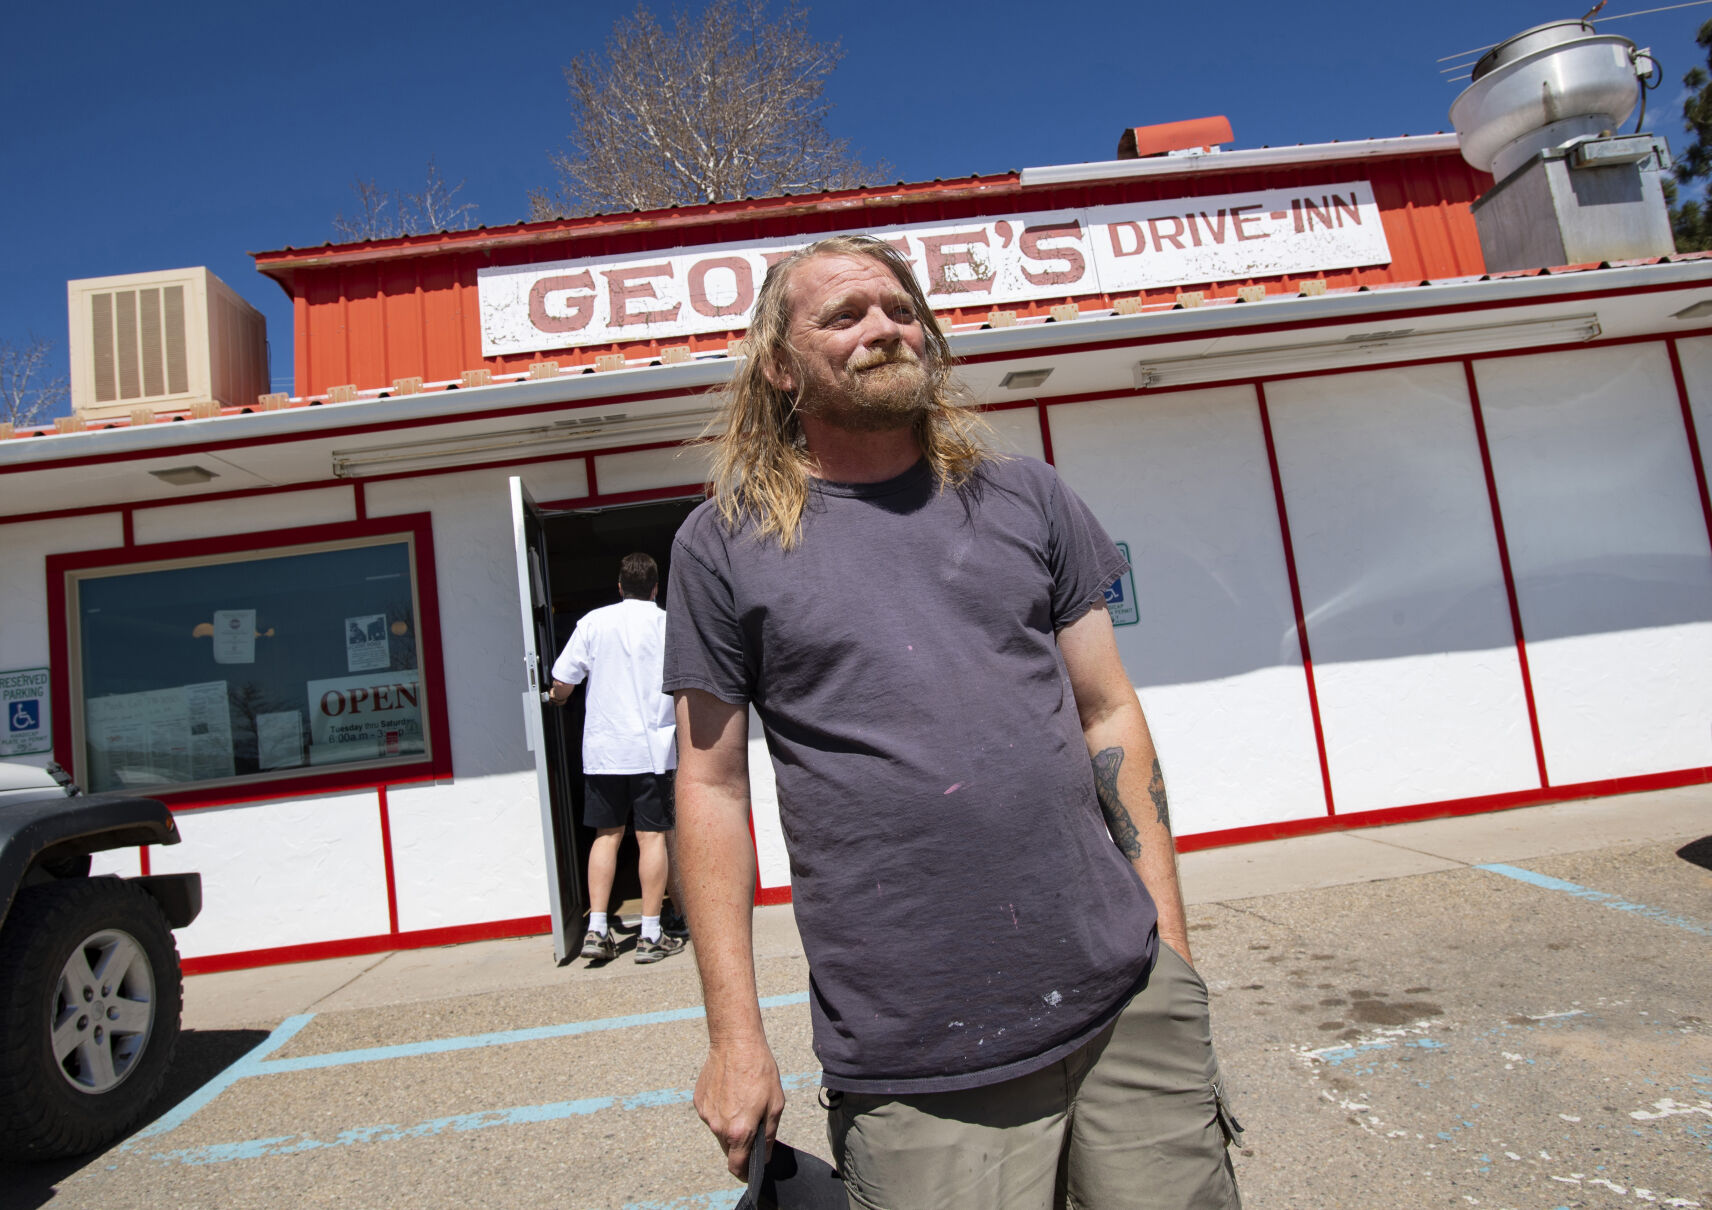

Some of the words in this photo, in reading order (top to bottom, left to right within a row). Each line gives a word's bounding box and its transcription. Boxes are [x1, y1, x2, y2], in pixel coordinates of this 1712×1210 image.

[529, 218, 1086, 333] GEOE'S
[1107, 192, 1363, 258] DRIVE-INN
[0, 674, 47, 688] RESERVED
[3, 687, 44, 700] PARKING
[321, 682, 418, 717] OPEN
[330, 723, 363, 733] Tuesday
